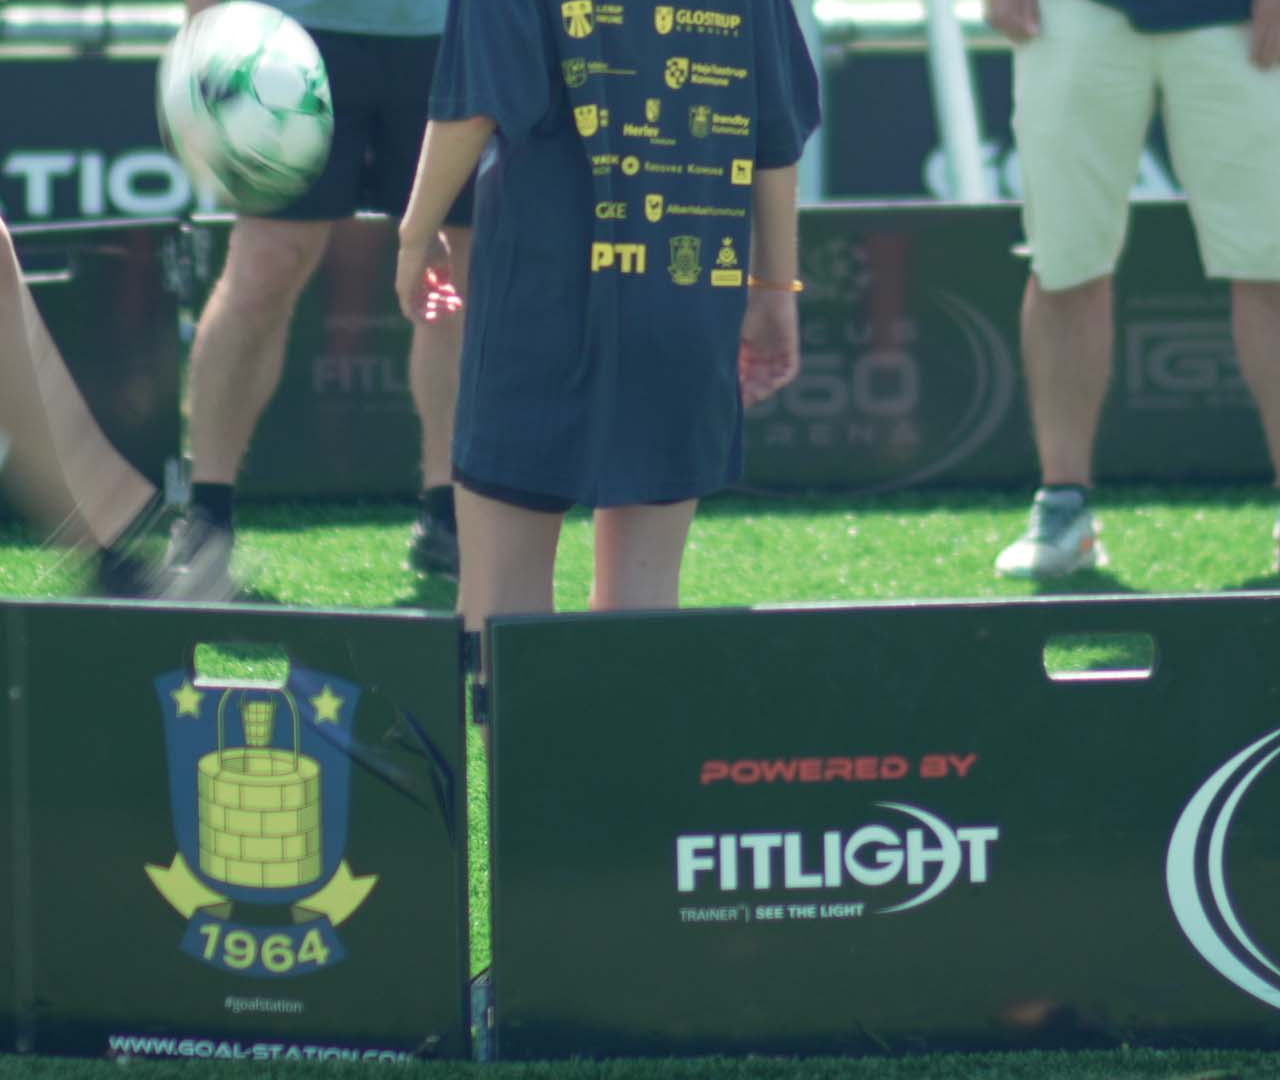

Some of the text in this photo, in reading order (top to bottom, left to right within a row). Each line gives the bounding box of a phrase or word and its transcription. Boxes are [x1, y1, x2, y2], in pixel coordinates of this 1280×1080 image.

[699, 753, 978, 785] POWERED BY
[676, 824, 1000, 893] FITLIGHT
[680, 901, 866, 923] TRAINER SEE THE LIGHT
[198, 922, 331, 975] 1964
[224, 994, 304, 1014] #goalstation
